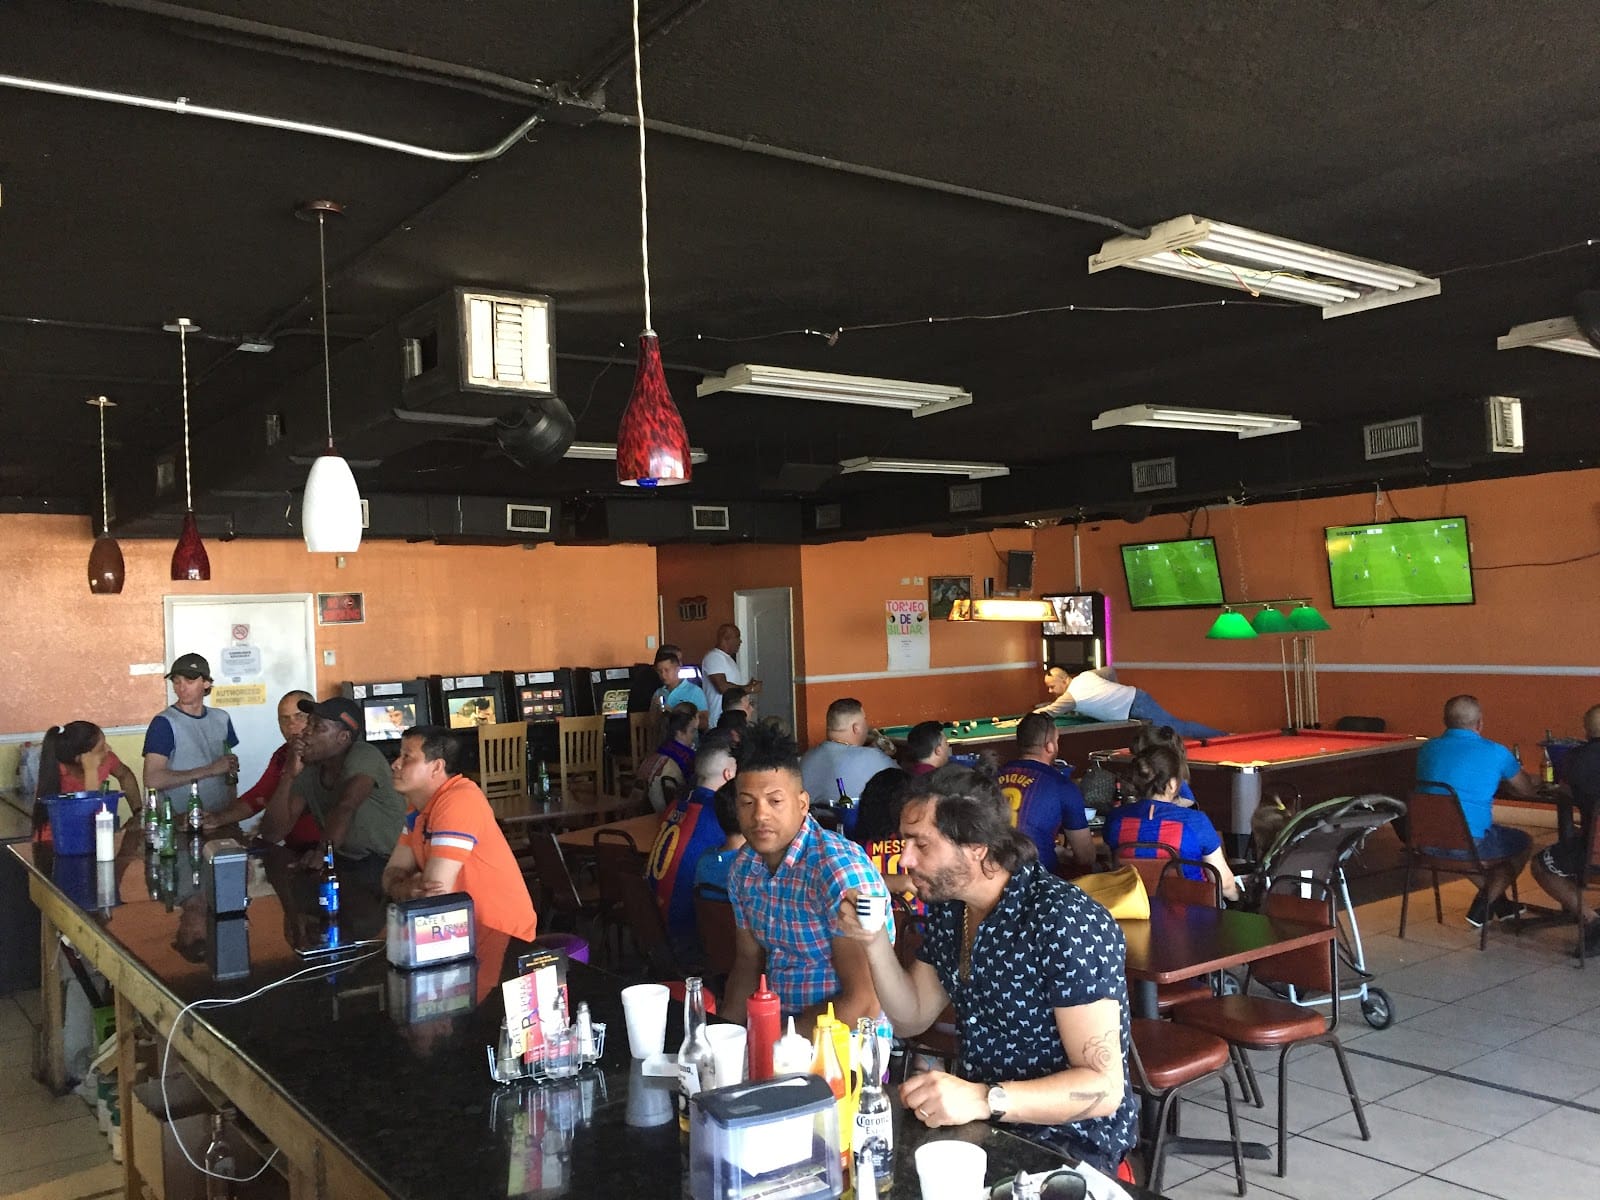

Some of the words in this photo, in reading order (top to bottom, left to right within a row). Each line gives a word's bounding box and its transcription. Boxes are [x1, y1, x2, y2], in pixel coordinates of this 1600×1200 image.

[887, 601, 925, 612] TORNEO
[900, 613, 911, 624] DE
[887, 624, 923, 636] BILLIAR
